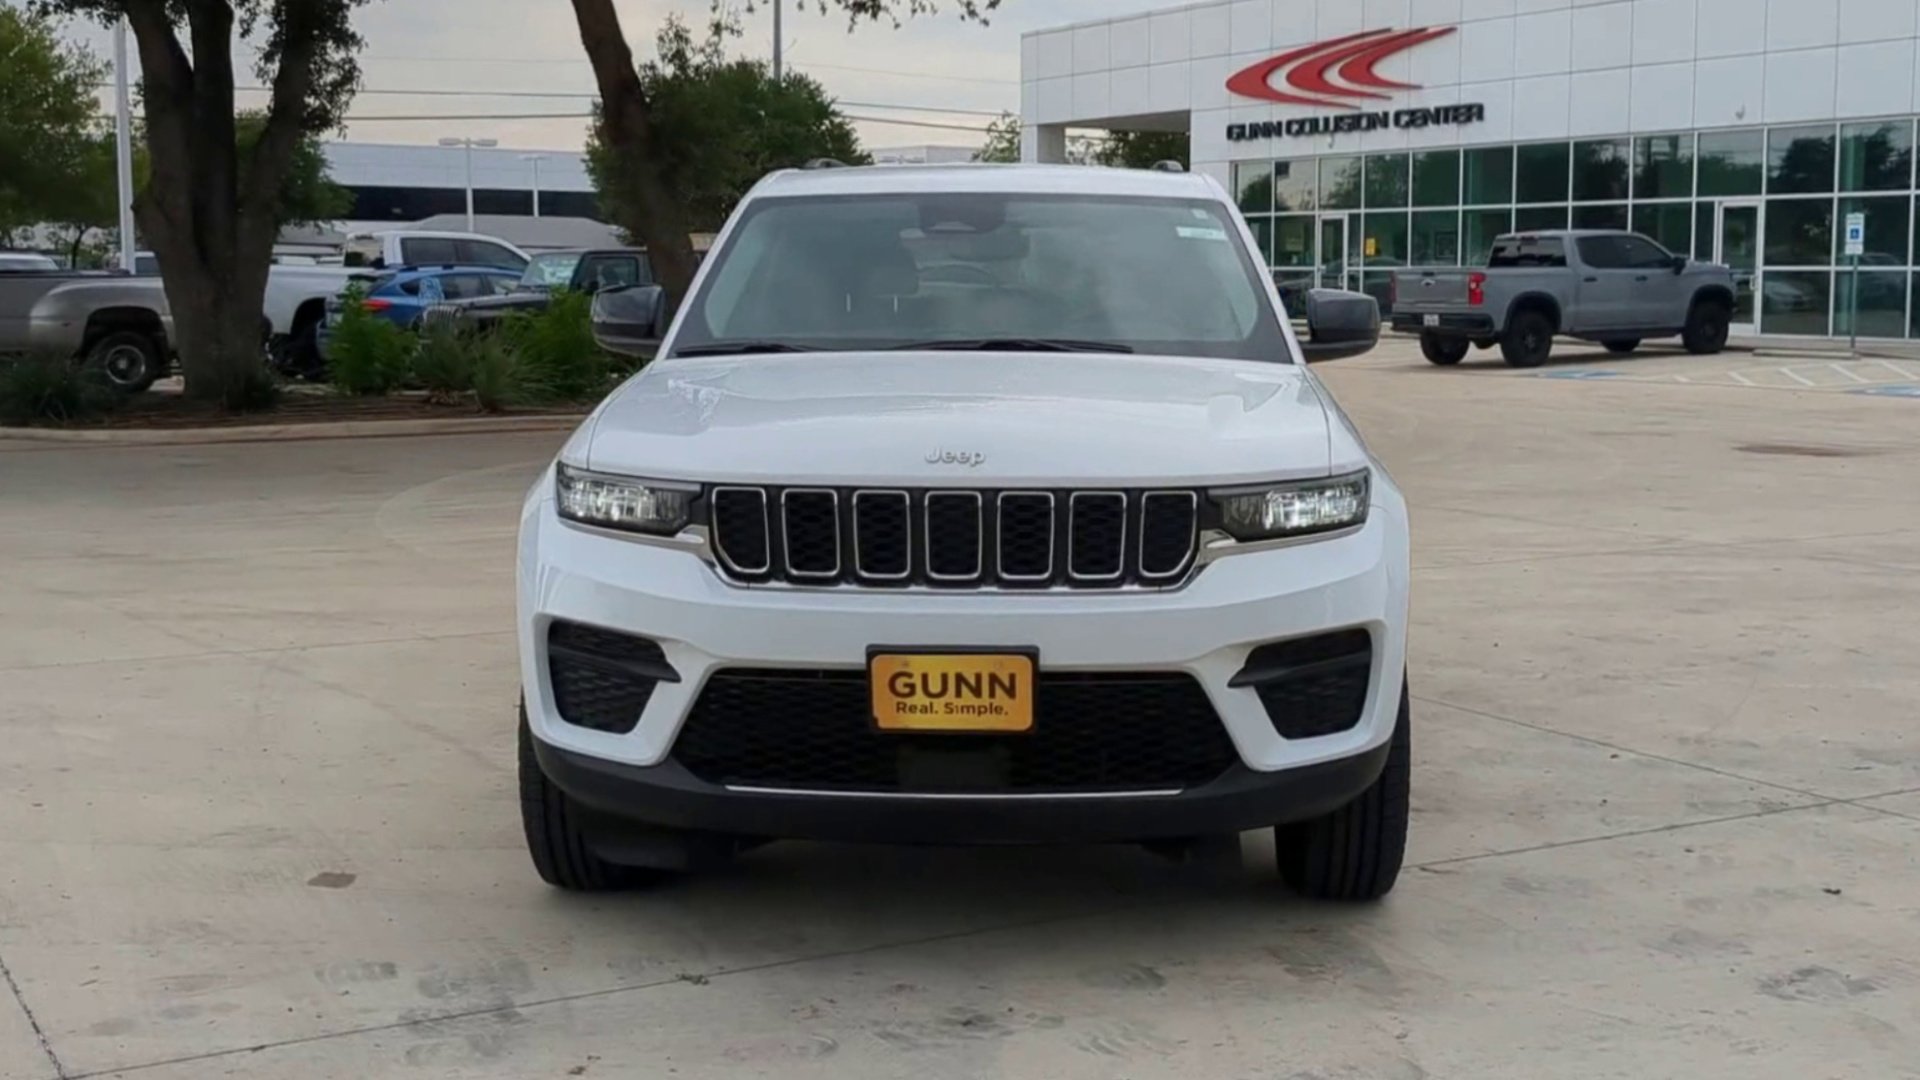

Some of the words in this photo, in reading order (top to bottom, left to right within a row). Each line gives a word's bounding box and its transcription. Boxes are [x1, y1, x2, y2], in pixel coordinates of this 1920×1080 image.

[1226, 120, 1282, 142] GUNN
[1285, 111, 1389, 137] COLLISION
[1393, 103, 1484, 129] CENTER
[925, 446, 986, 467] Jeep
[888, 671, 1017, 699] GUNN
[896, 702, 939, 714] Real.
[944, 702, 1008, 717] Simple.
